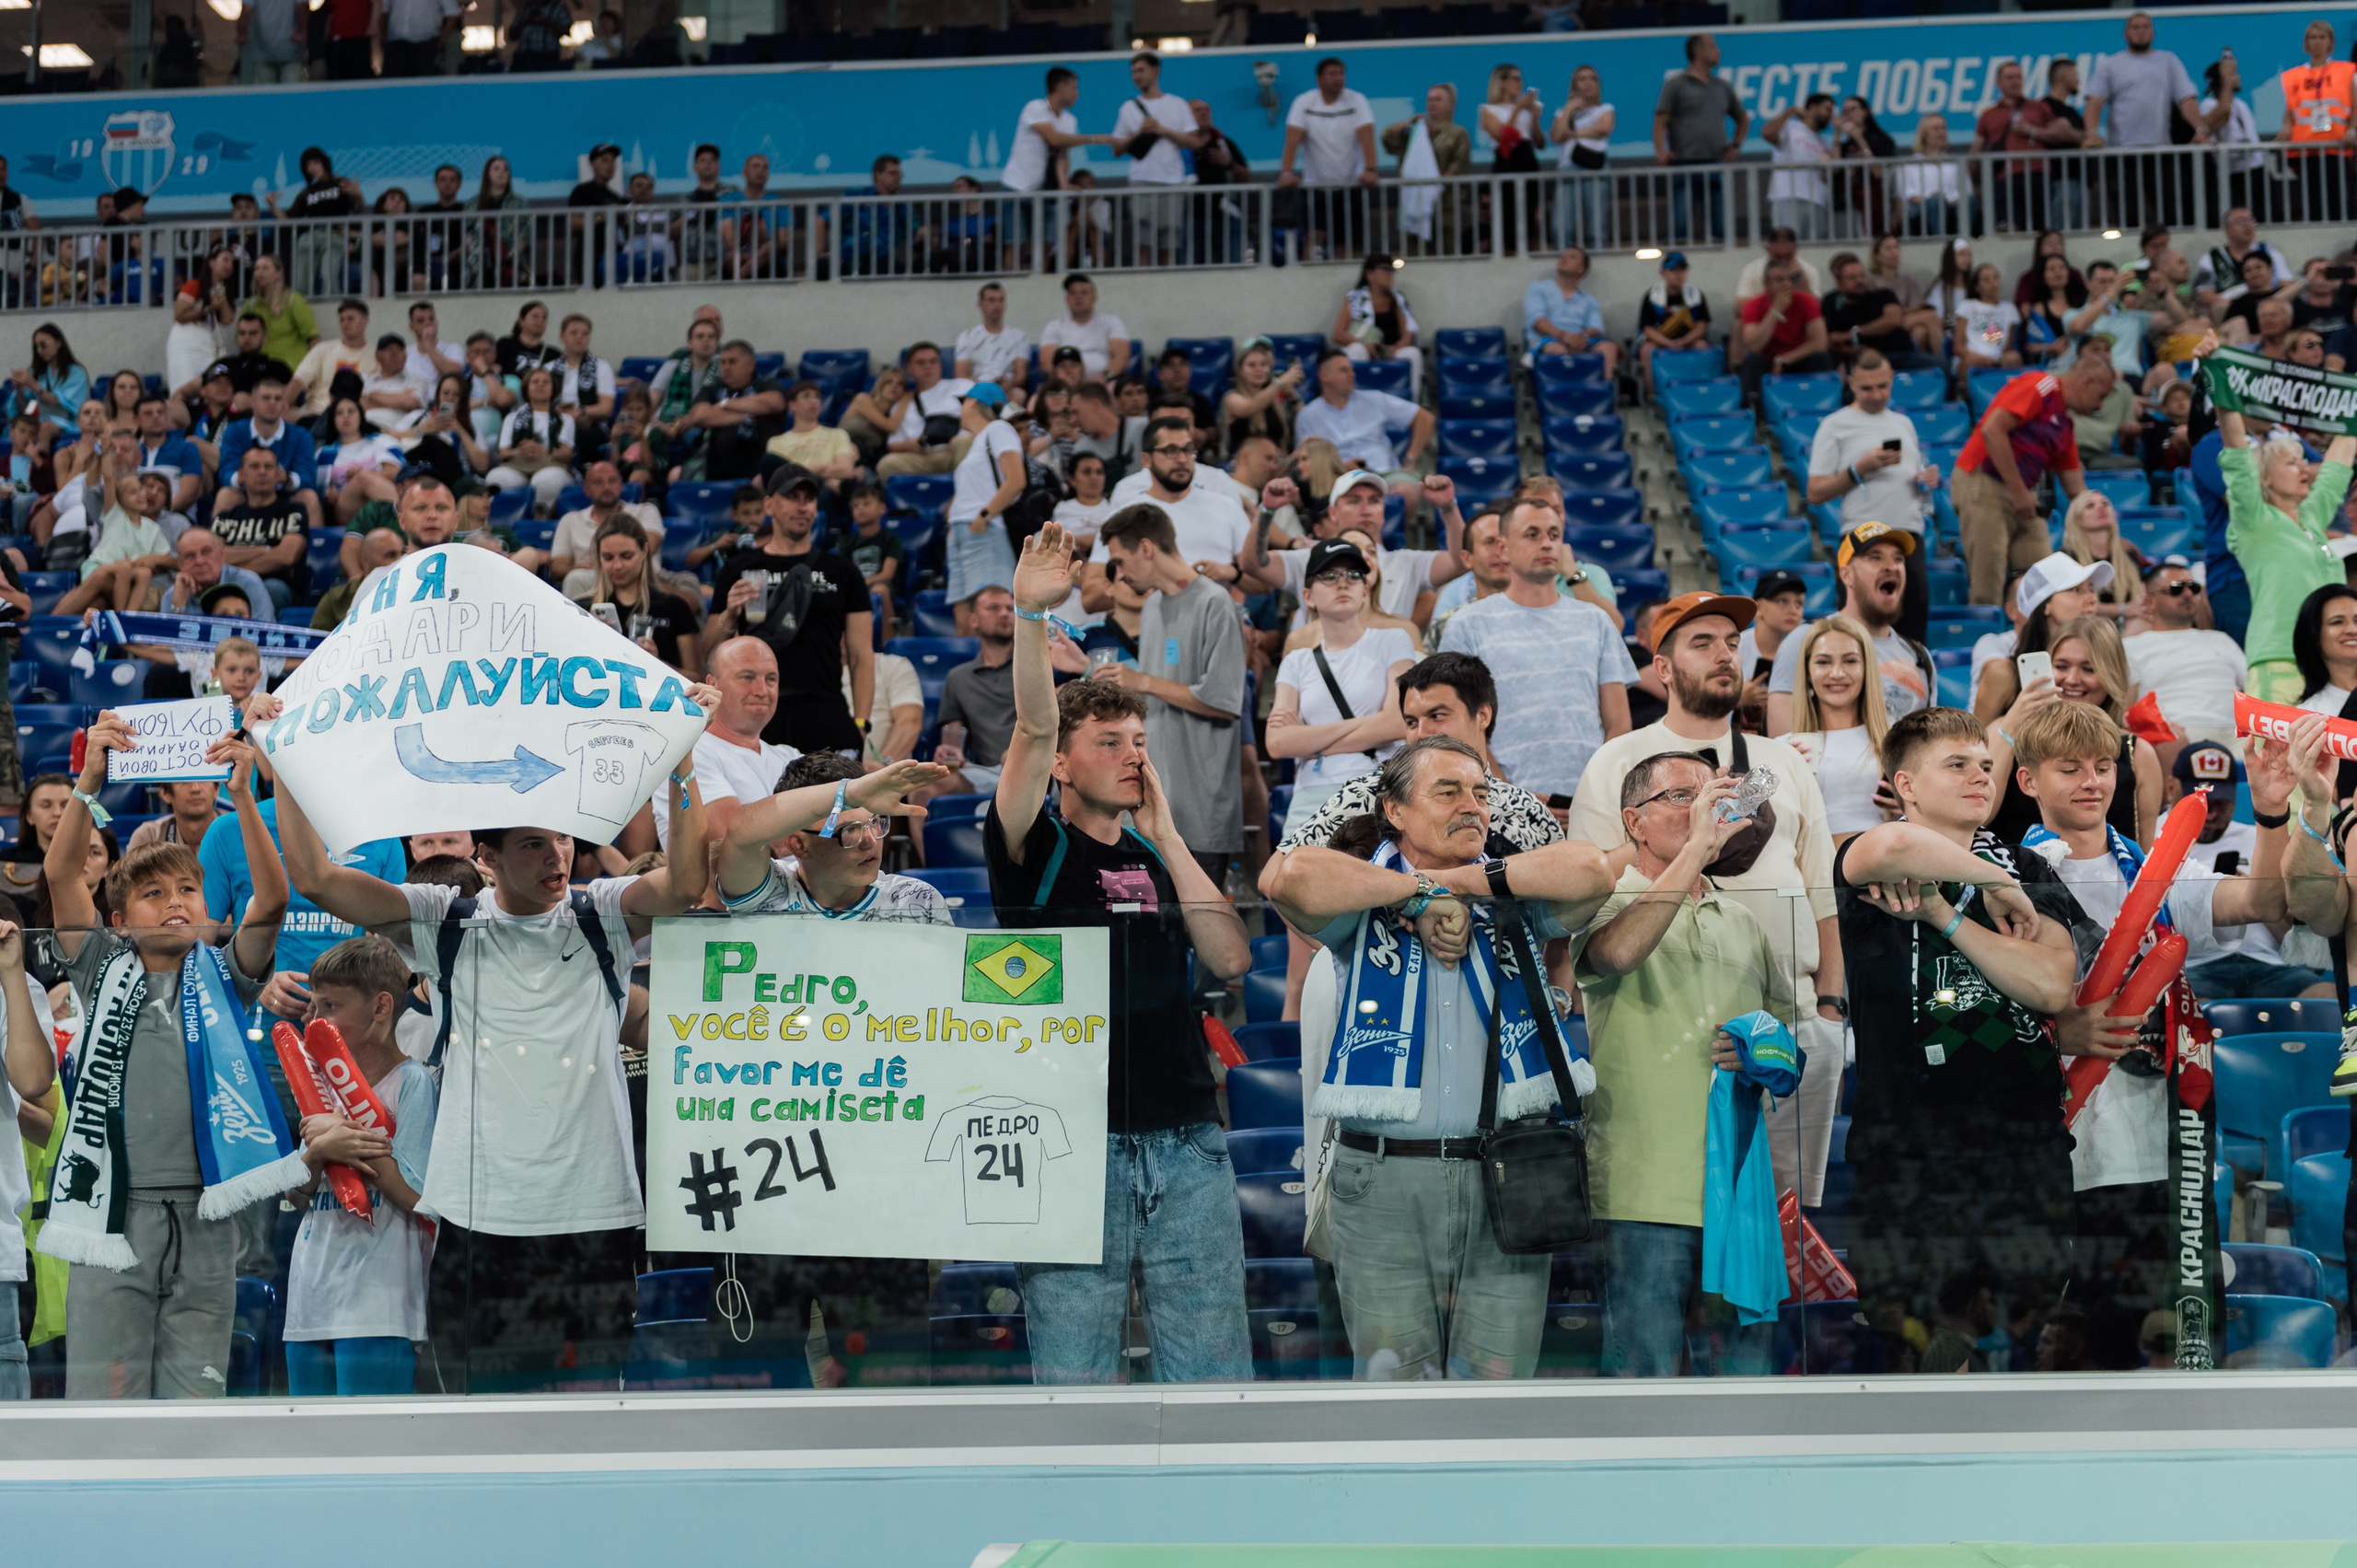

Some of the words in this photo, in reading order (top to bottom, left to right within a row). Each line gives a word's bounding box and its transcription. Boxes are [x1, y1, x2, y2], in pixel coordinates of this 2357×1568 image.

[1664, 62, 1848, 121] ЕСТЕ
[286, 602, 536, 703] ПОДАРИ
[265, 652, 703, 755] ПОЖАЛУЙСТА
[588, 736, 634, 749] СЕРГЕЕВ
[593, 759, 624, 784] 33
[284, 912, 354, 935] АЗПРОМ
[116, 1016, 134, 1048] 23/24
[184, 998, 200, 1042] ФИНАЛ
[111, 1059, 124, 1071] 13
[1383, 1044, 1407, 1057] 1925
[231, 1059, 249, 1085] 1925
[108, 1072, 122, 1108] ИЮЛЯ
[967, 1115, 1039, 1138] ПЕДРО
[973, 1142, 1025, 1188] 24
